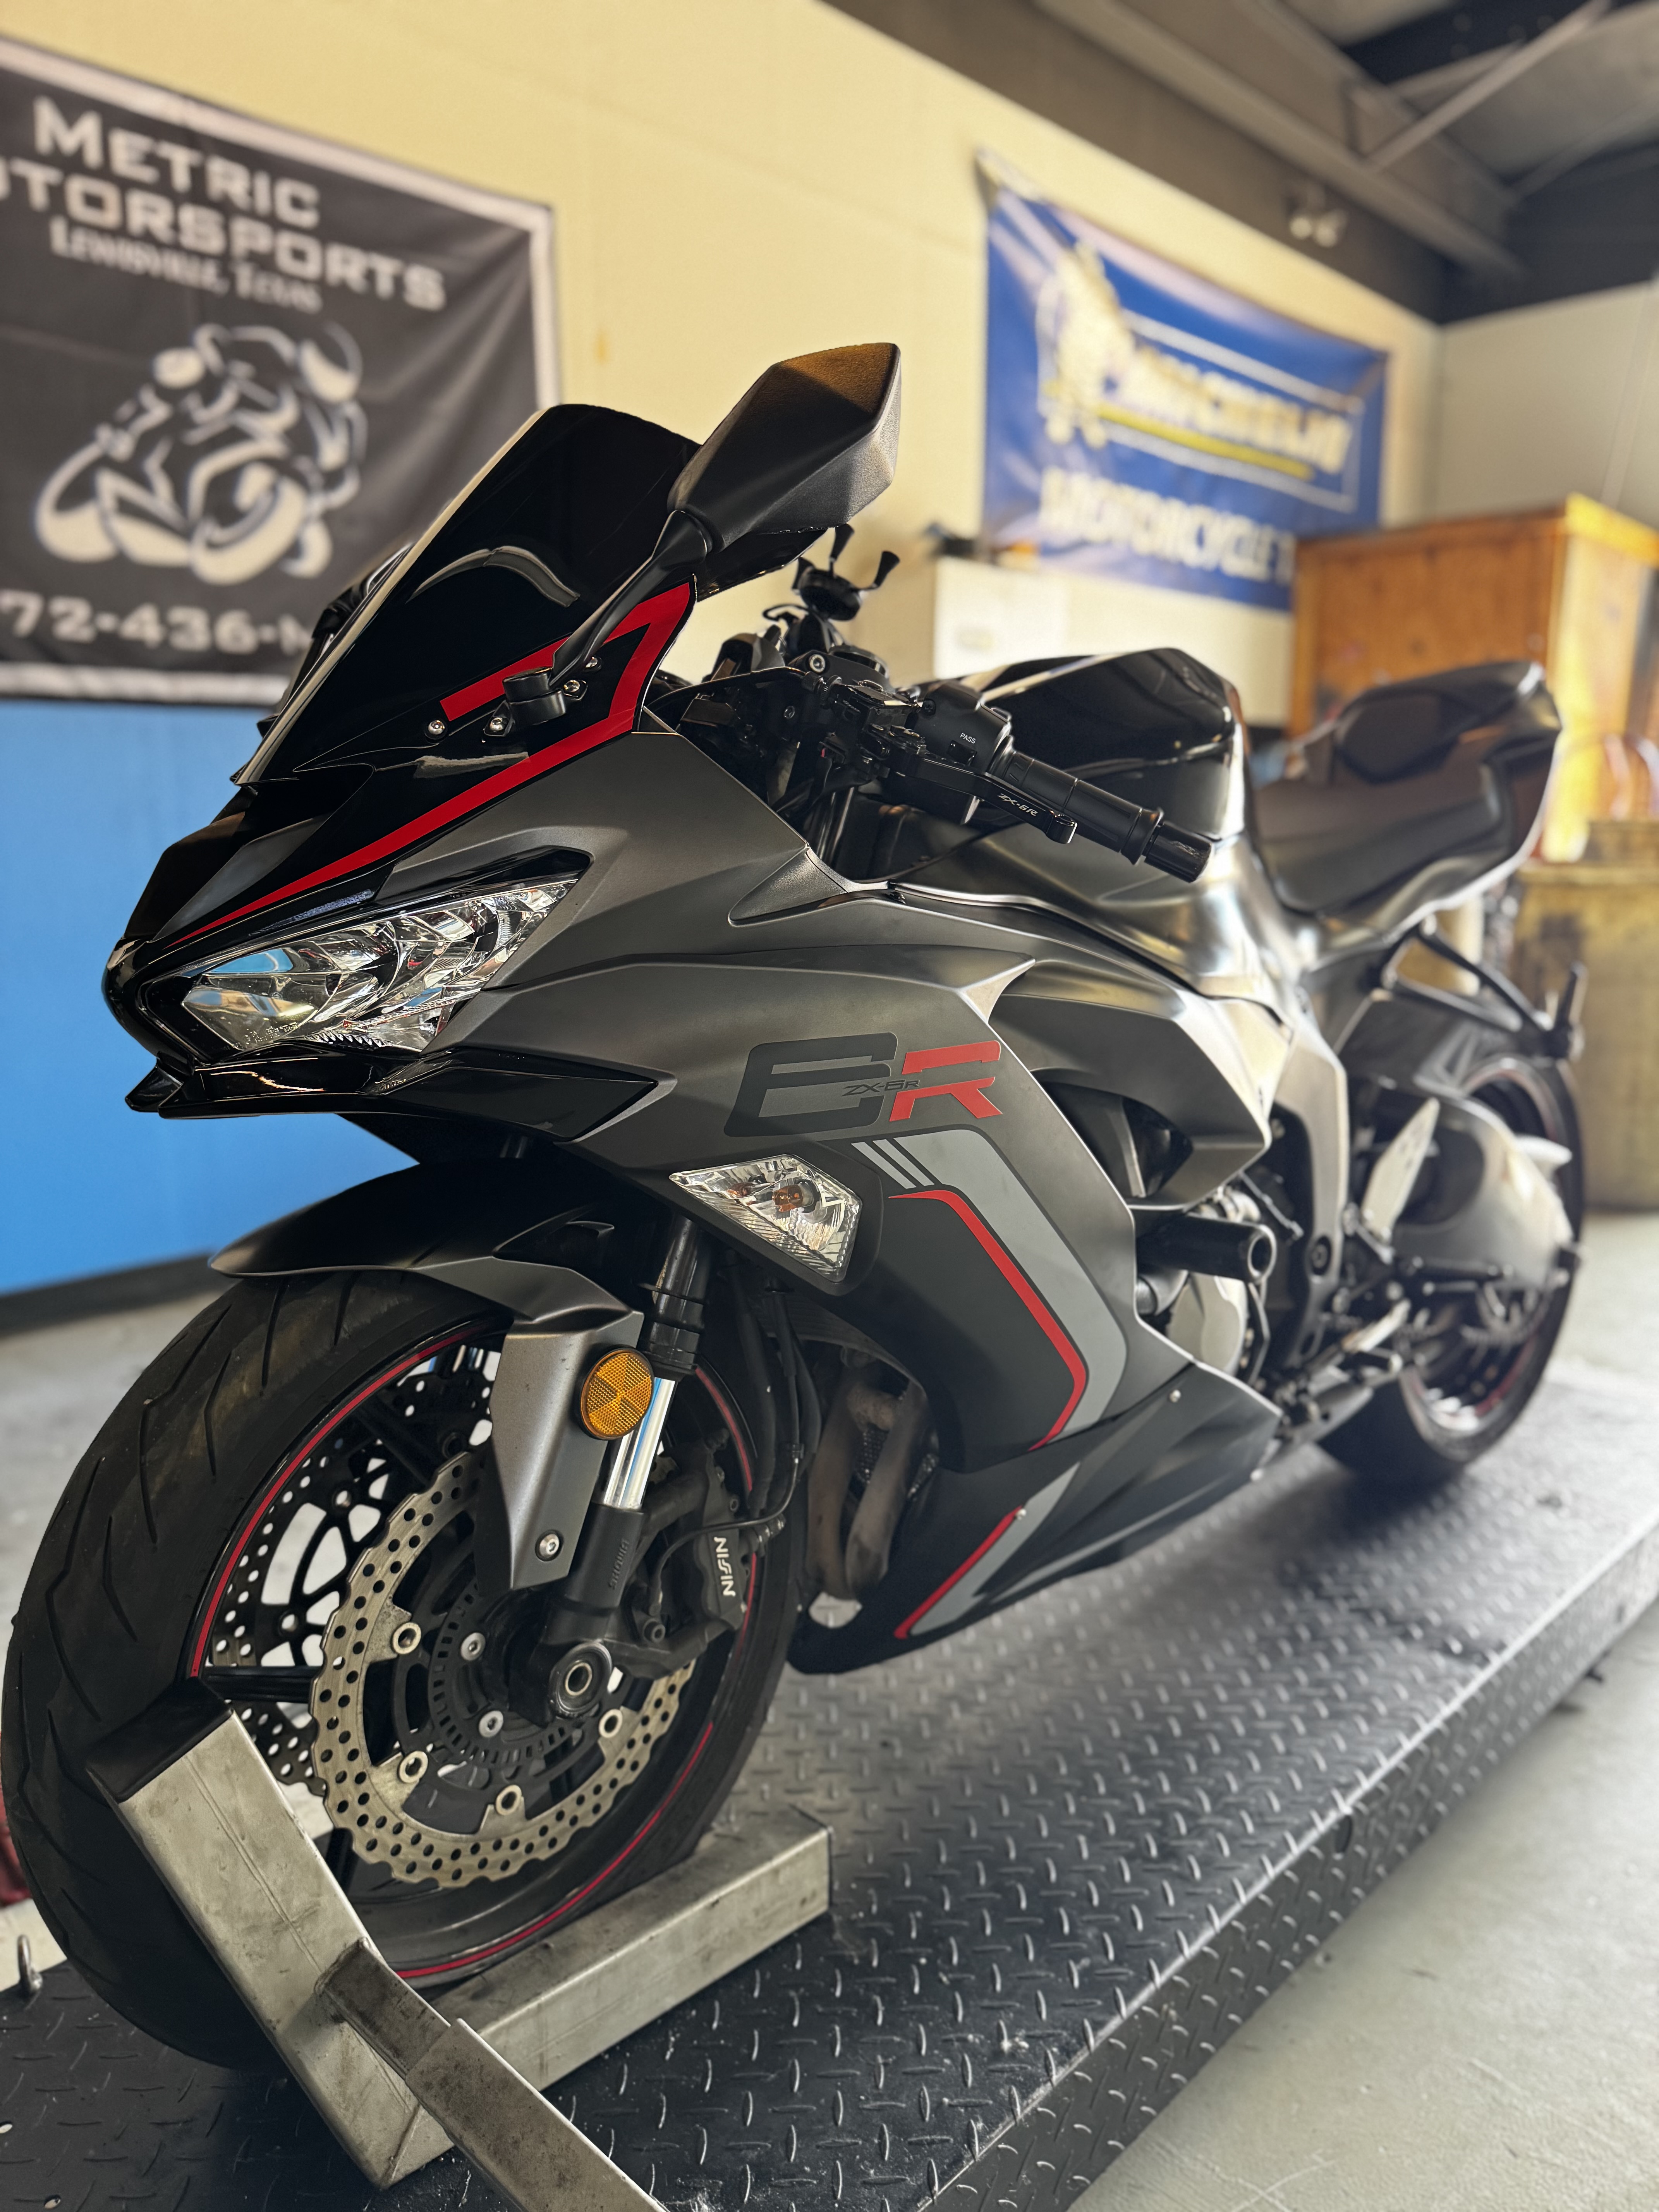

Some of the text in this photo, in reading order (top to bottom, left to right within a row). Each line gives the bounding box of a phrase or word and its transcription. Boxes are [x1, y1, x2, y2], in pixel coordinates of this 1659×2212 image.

[32, 95, 321, 229] METRIC
[0, 156, 447, 311] TORSPORTS
[960, 733, 976, 744] PASS
[997, 793, 1038, 816] ZX-6R
[841, 1079, 920, 1097] ZX-6R
[713, 1537, 736, 1597] NISSIN
